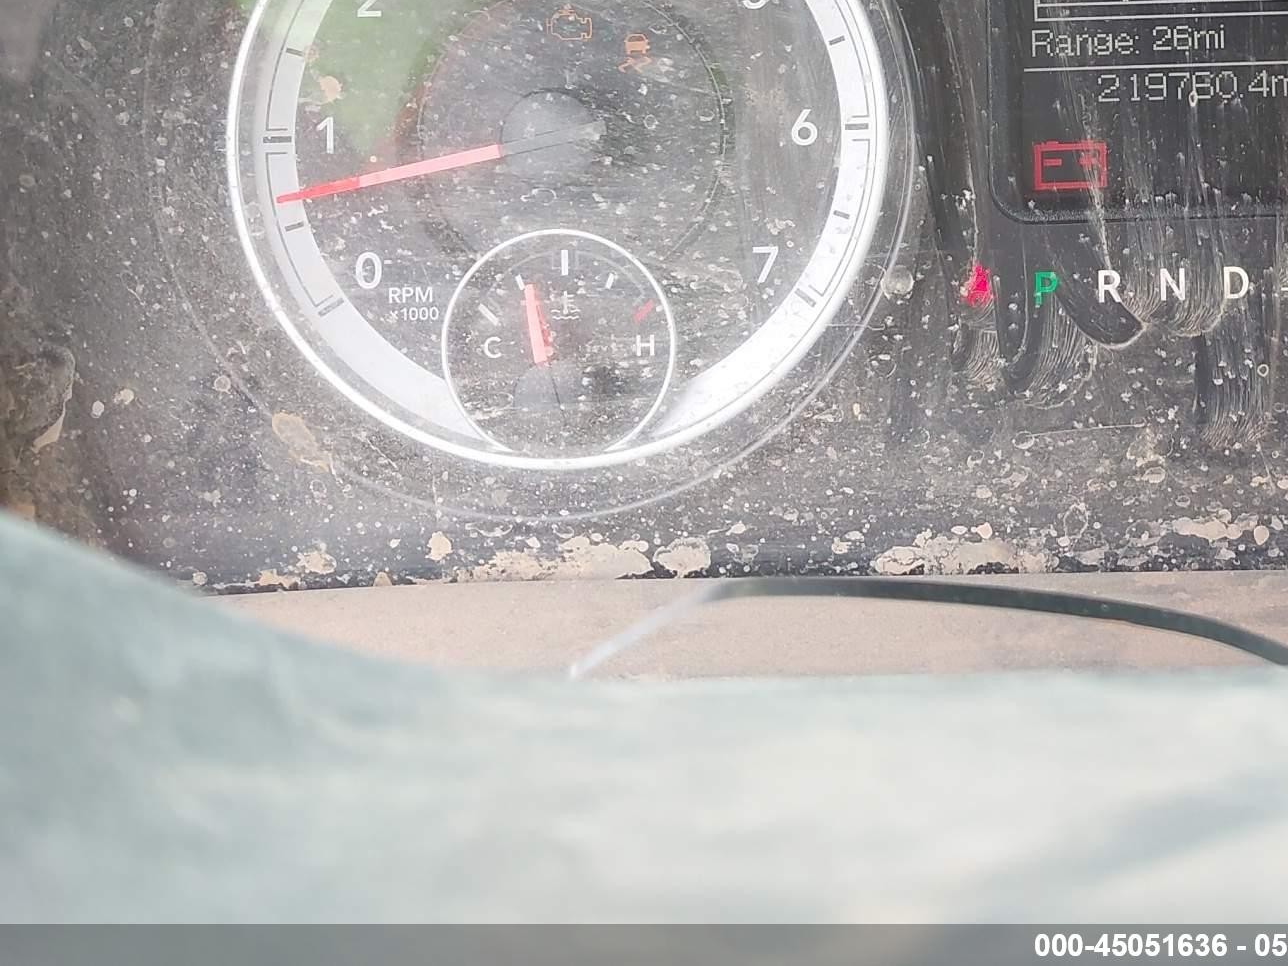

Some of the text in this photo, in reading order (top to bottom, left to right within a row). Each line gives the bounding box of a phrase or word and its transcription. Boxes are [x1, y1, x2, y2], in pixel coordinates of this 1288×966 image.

[1031, 25, 1225, 57] Range: 26mi
[316, 118, 334, 154] 1
[792, 109, 818, 146] 6
[355, 252, 383, 289] 0
[752, 247, 779, 283] 7
[388, 287, 433, 303] RPM
[1034, 271, 1060, 307] P
[1098, 269, 1123, 304] R
[1159, 267, 1185, 301] N
[1223, 266, 1250, 300] D
[483, 337, 502, 358] C
[636, 335, 655, 356] H
